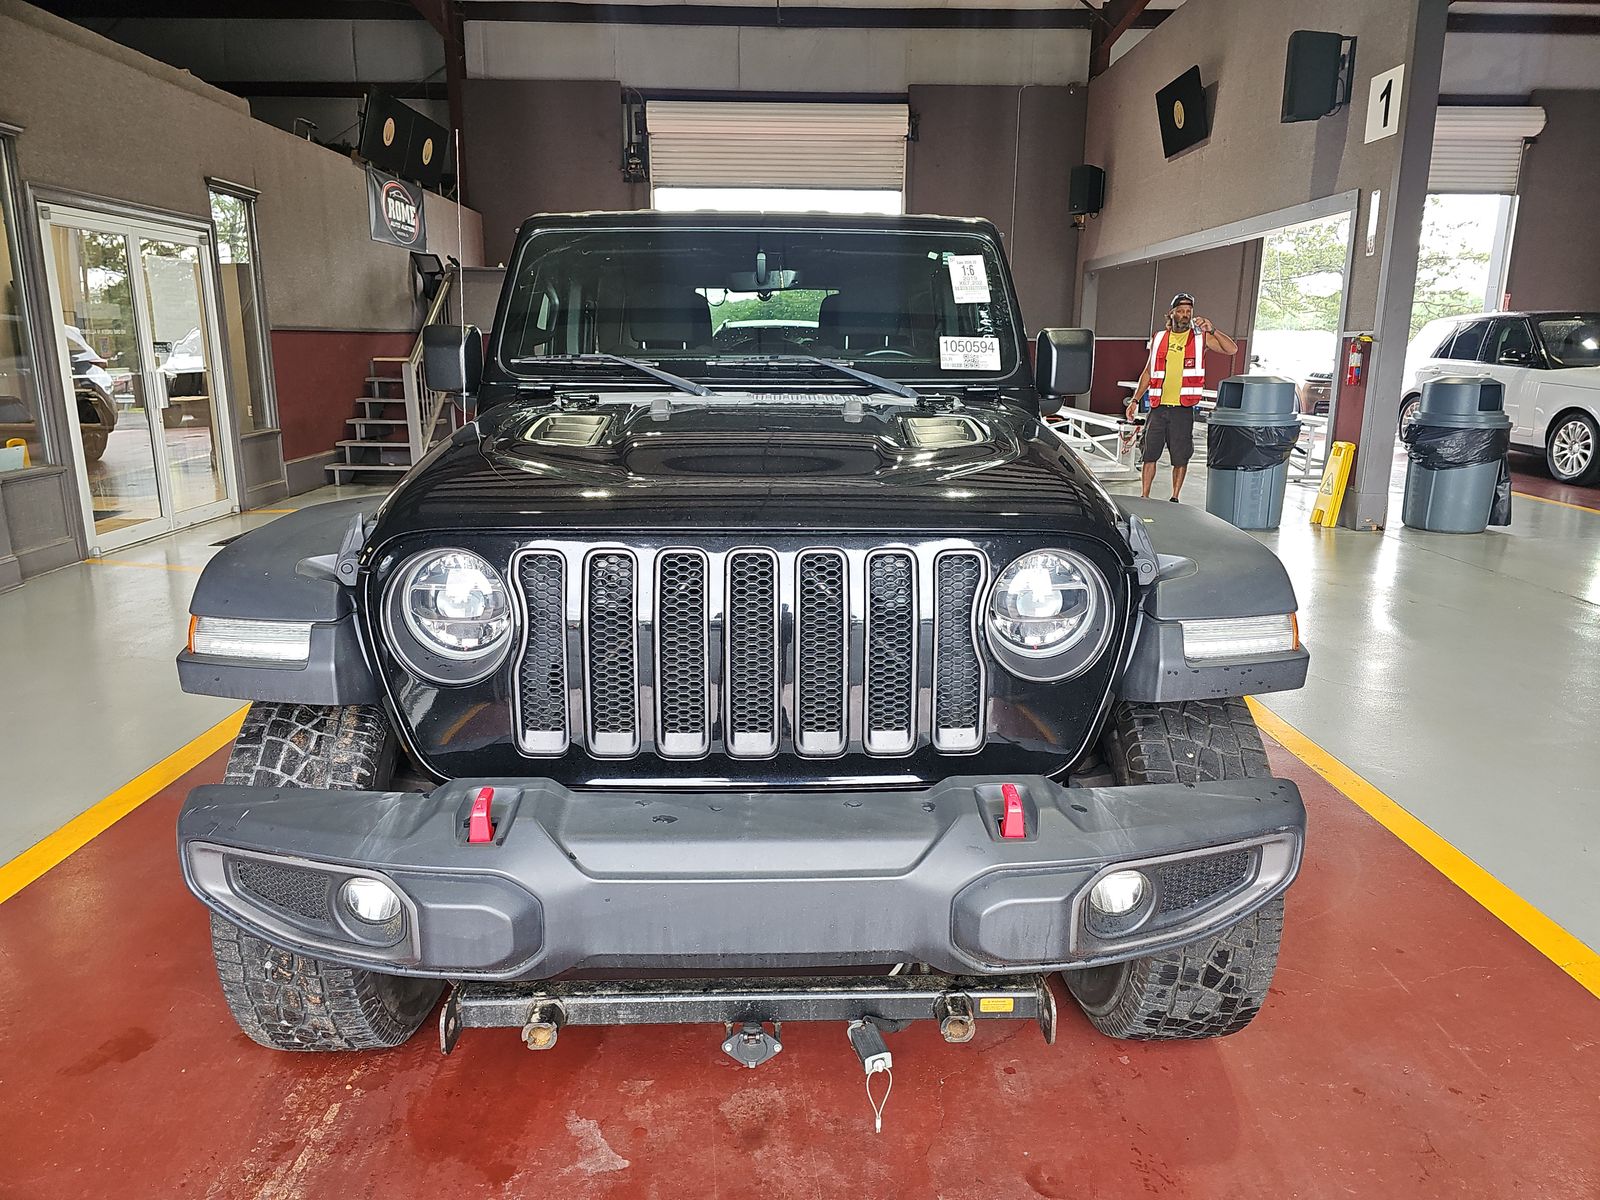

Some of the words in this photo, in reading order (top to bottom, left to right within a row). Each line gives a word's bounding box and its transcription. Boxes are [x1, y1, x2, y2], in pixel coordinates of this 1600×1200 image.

[1379, 79, 1393, 129] 1
[388, 197, 416, 225] ROME
[961, 264, 975, 276] 1:6
[944, 339, 995, 353] 1050594
